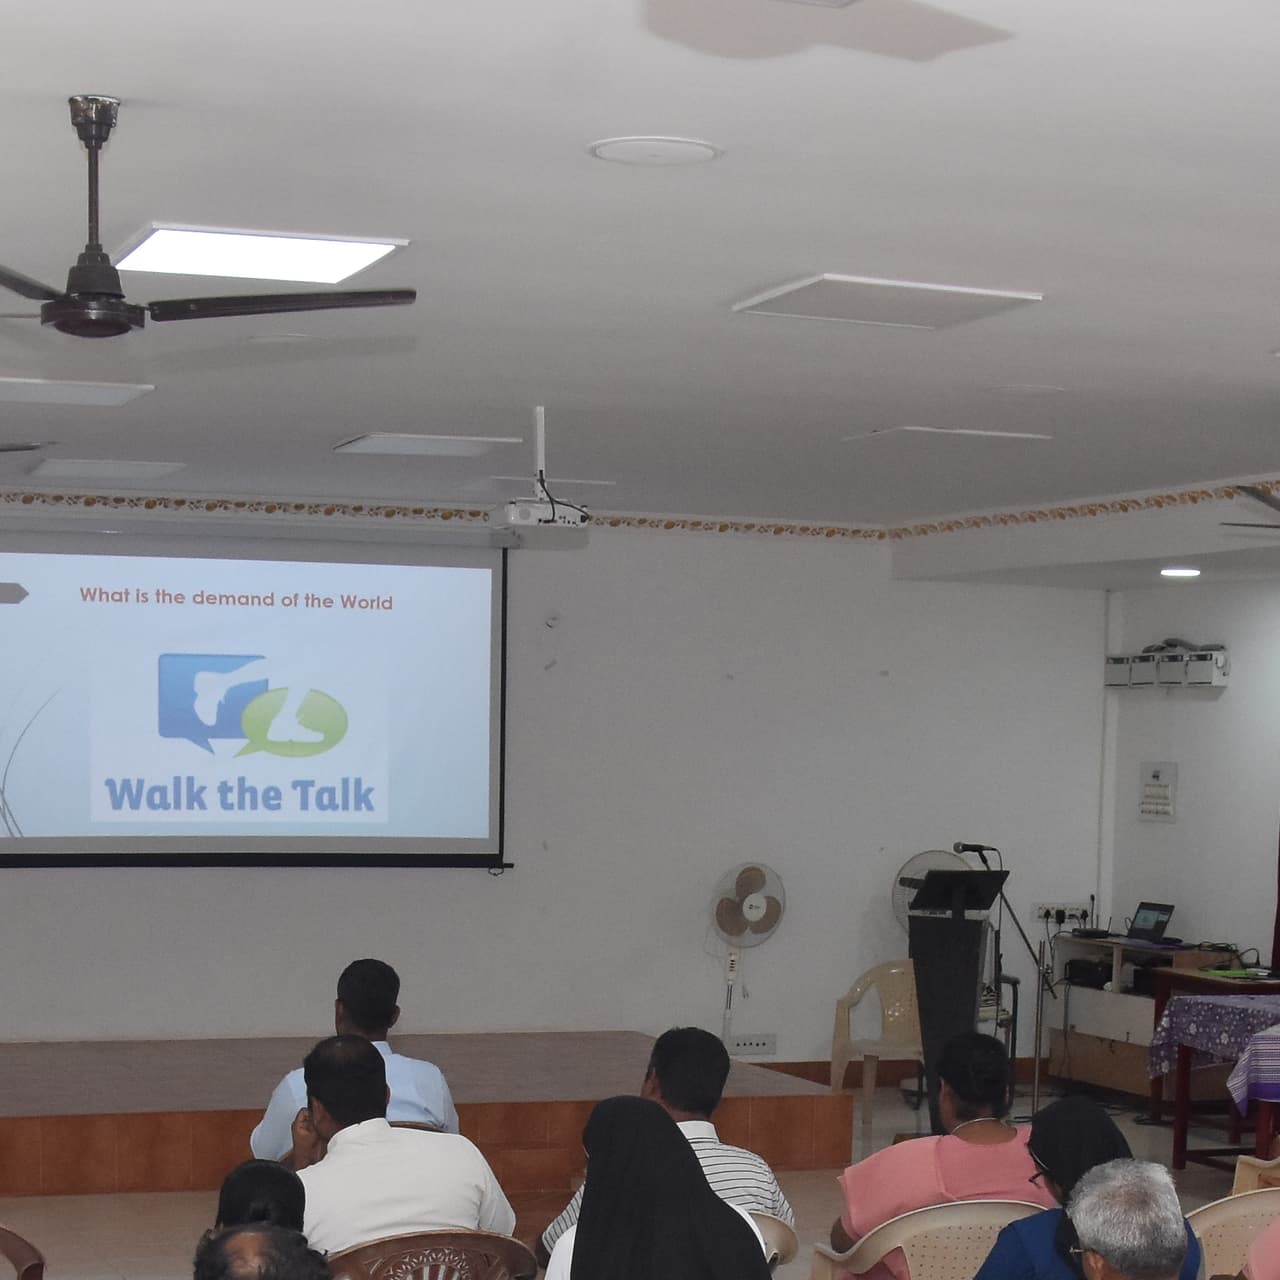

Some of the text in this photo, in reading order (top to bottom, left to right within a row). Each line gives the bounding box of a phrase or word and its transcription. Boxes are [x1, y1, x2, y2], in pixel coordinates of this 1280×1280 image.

[79, 586, 393, 611] What is the demand of the World
[104, 776, 376, 812] Walk the Talk
